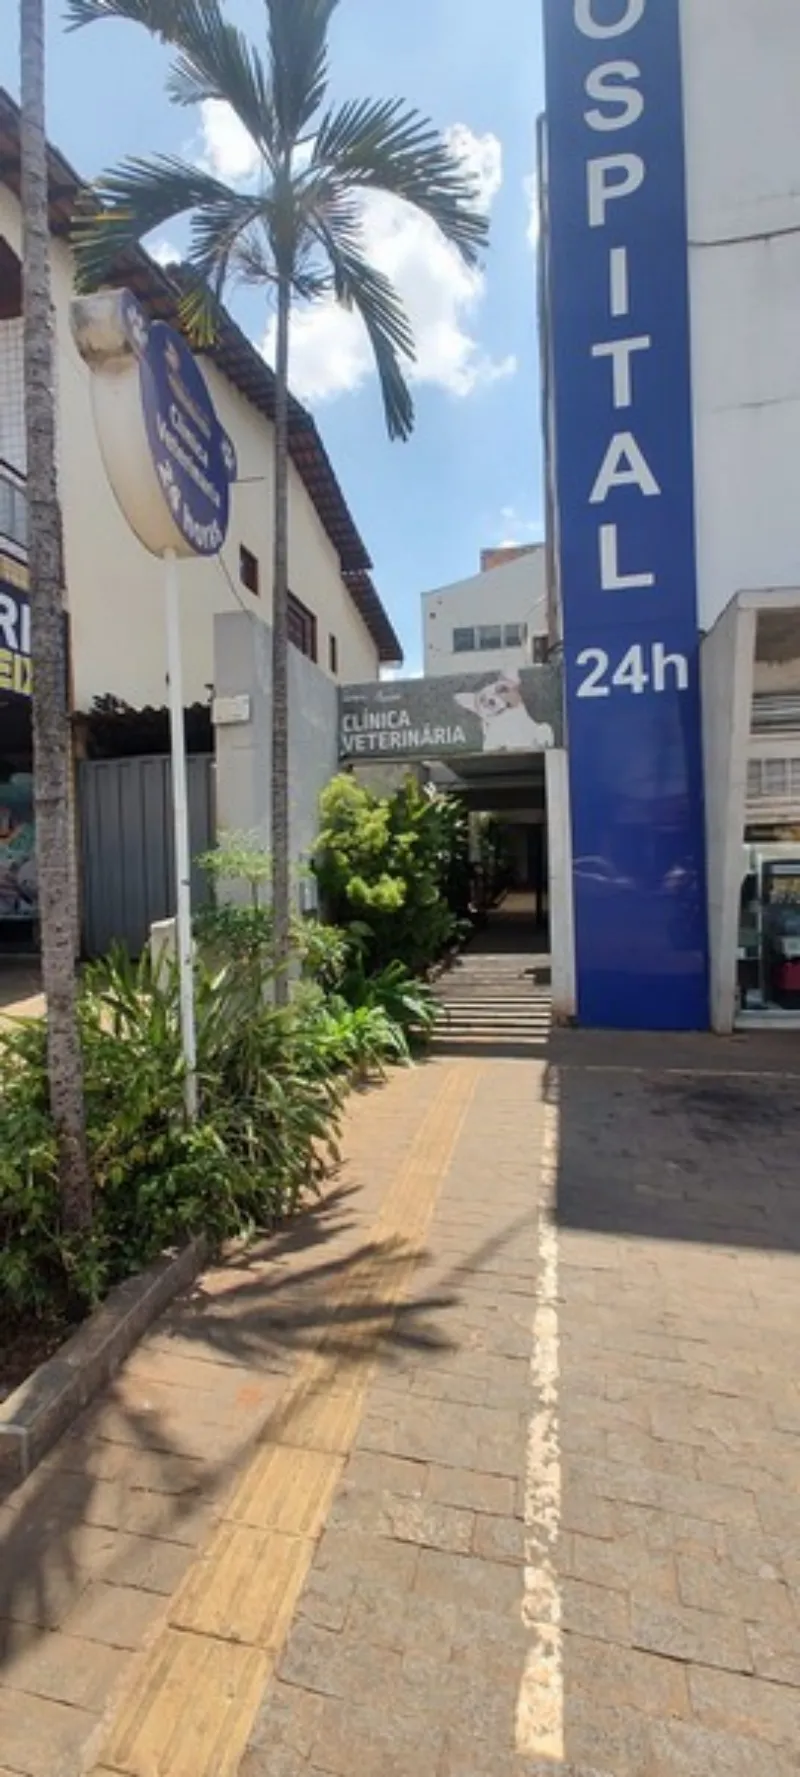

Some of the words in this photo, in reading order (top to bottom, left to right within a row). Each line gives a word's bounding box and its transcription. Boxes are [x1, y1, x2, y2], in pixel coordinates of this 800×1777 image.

[576, 642, 689, 698] 24h
[342, 707, 411, 733] CLÍNICA
[343, 722, 467, 752] VETERINÁRIA
